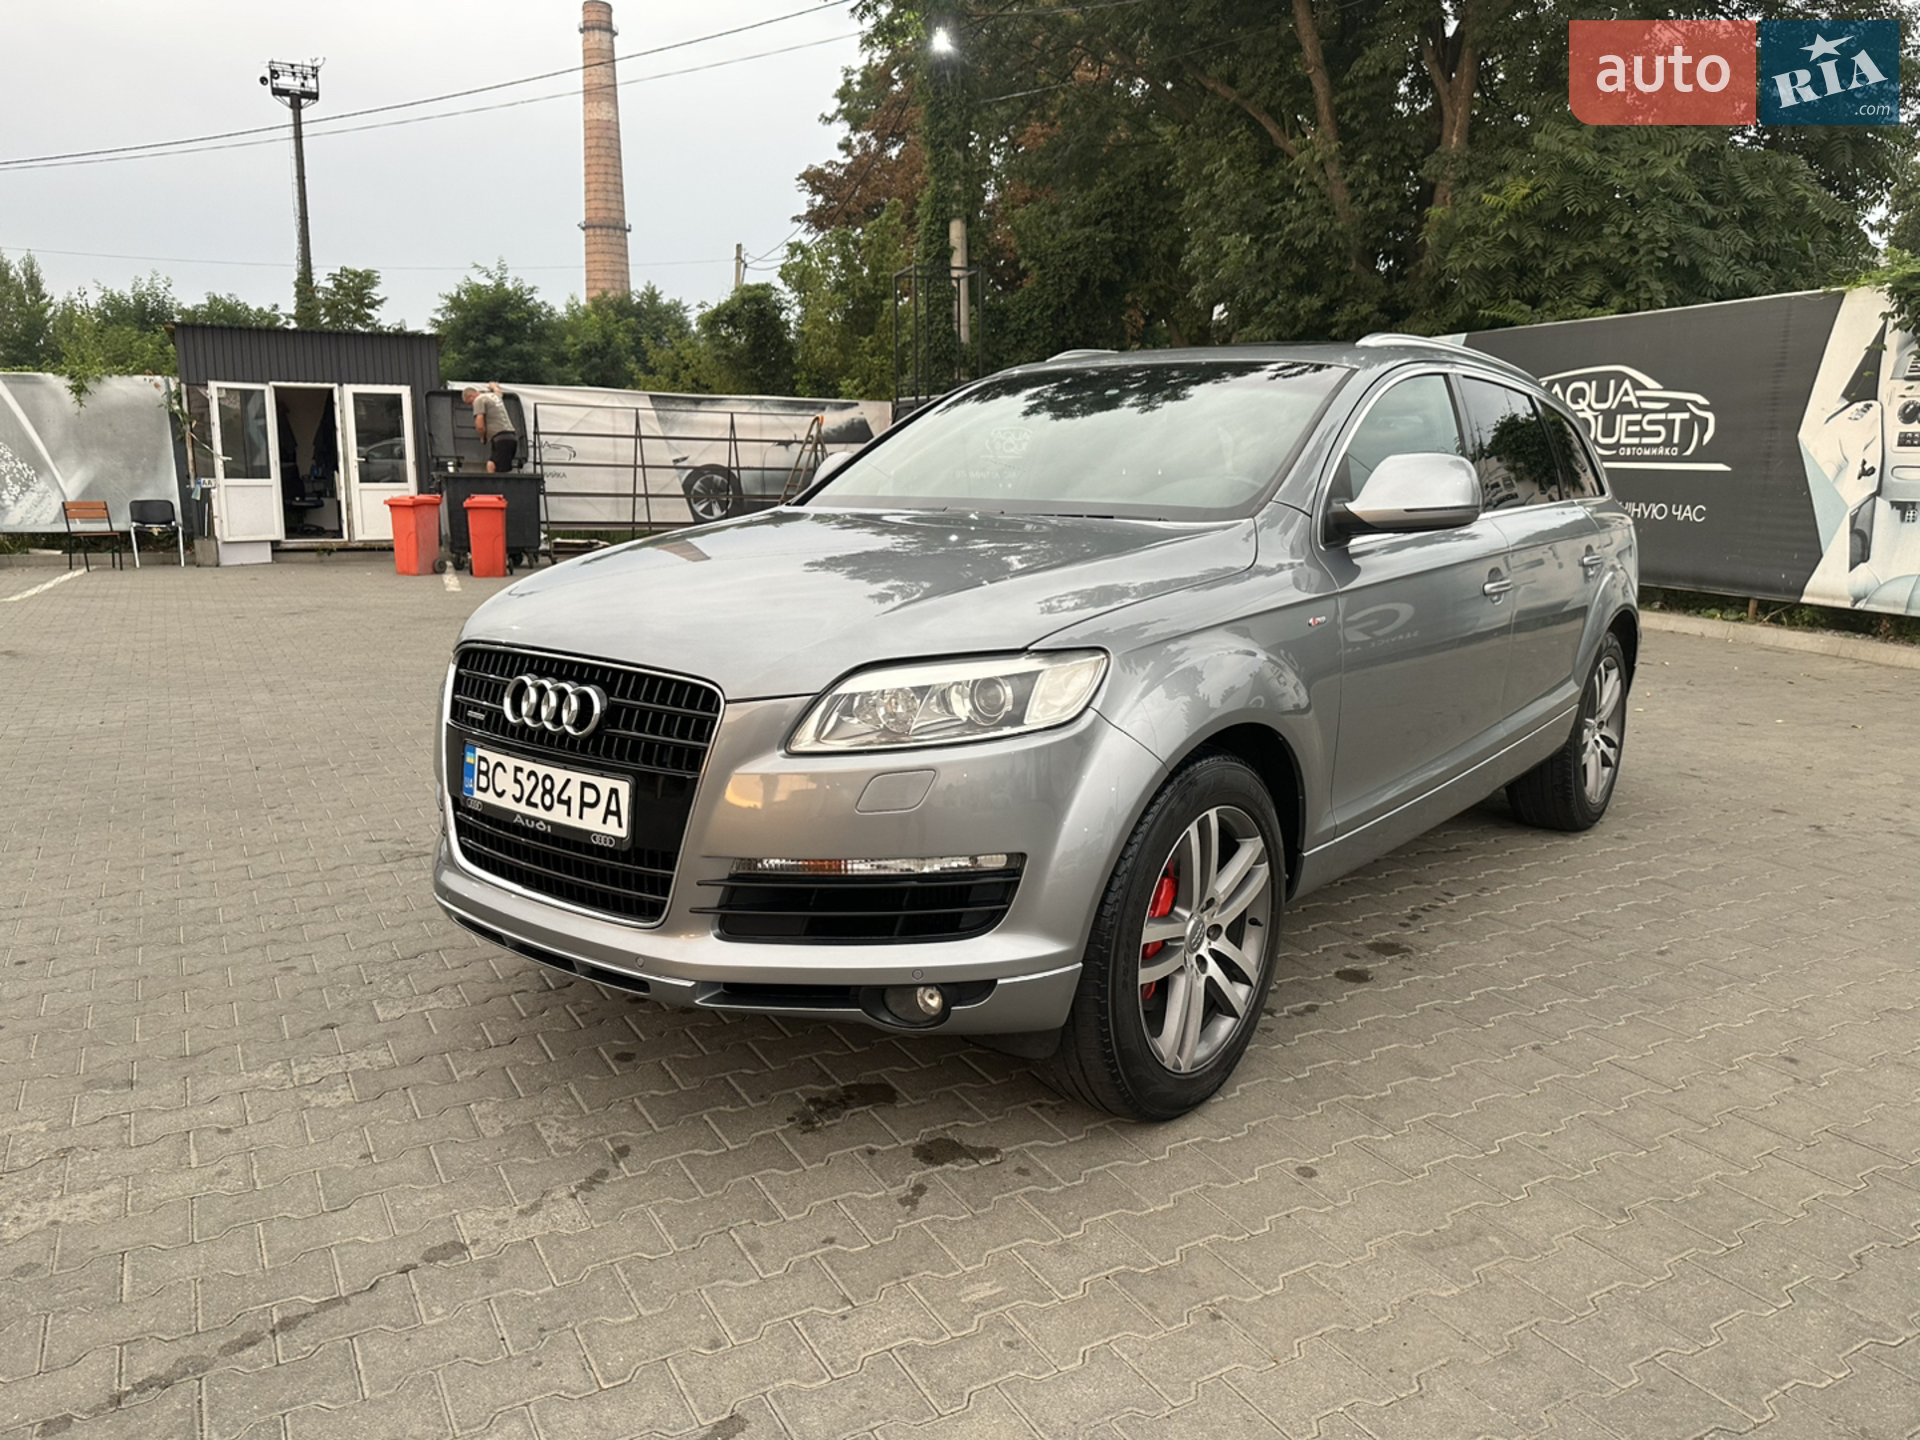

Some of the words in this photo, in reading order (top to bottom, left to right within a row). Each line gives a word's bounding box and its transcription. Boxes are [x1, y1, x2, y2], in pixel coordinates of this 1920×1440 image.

[1551, 378, 1640, 411] AQUA
[1618, 446, 1679, 456] автомийка
[1671, 504, 1707, 523] ЧАС
[476, 755, 507, 798] BC
[511, 765, 572, 818] 5284
[578, 780, 623, 829] PA
[513, 814, 551, 833] Audi
